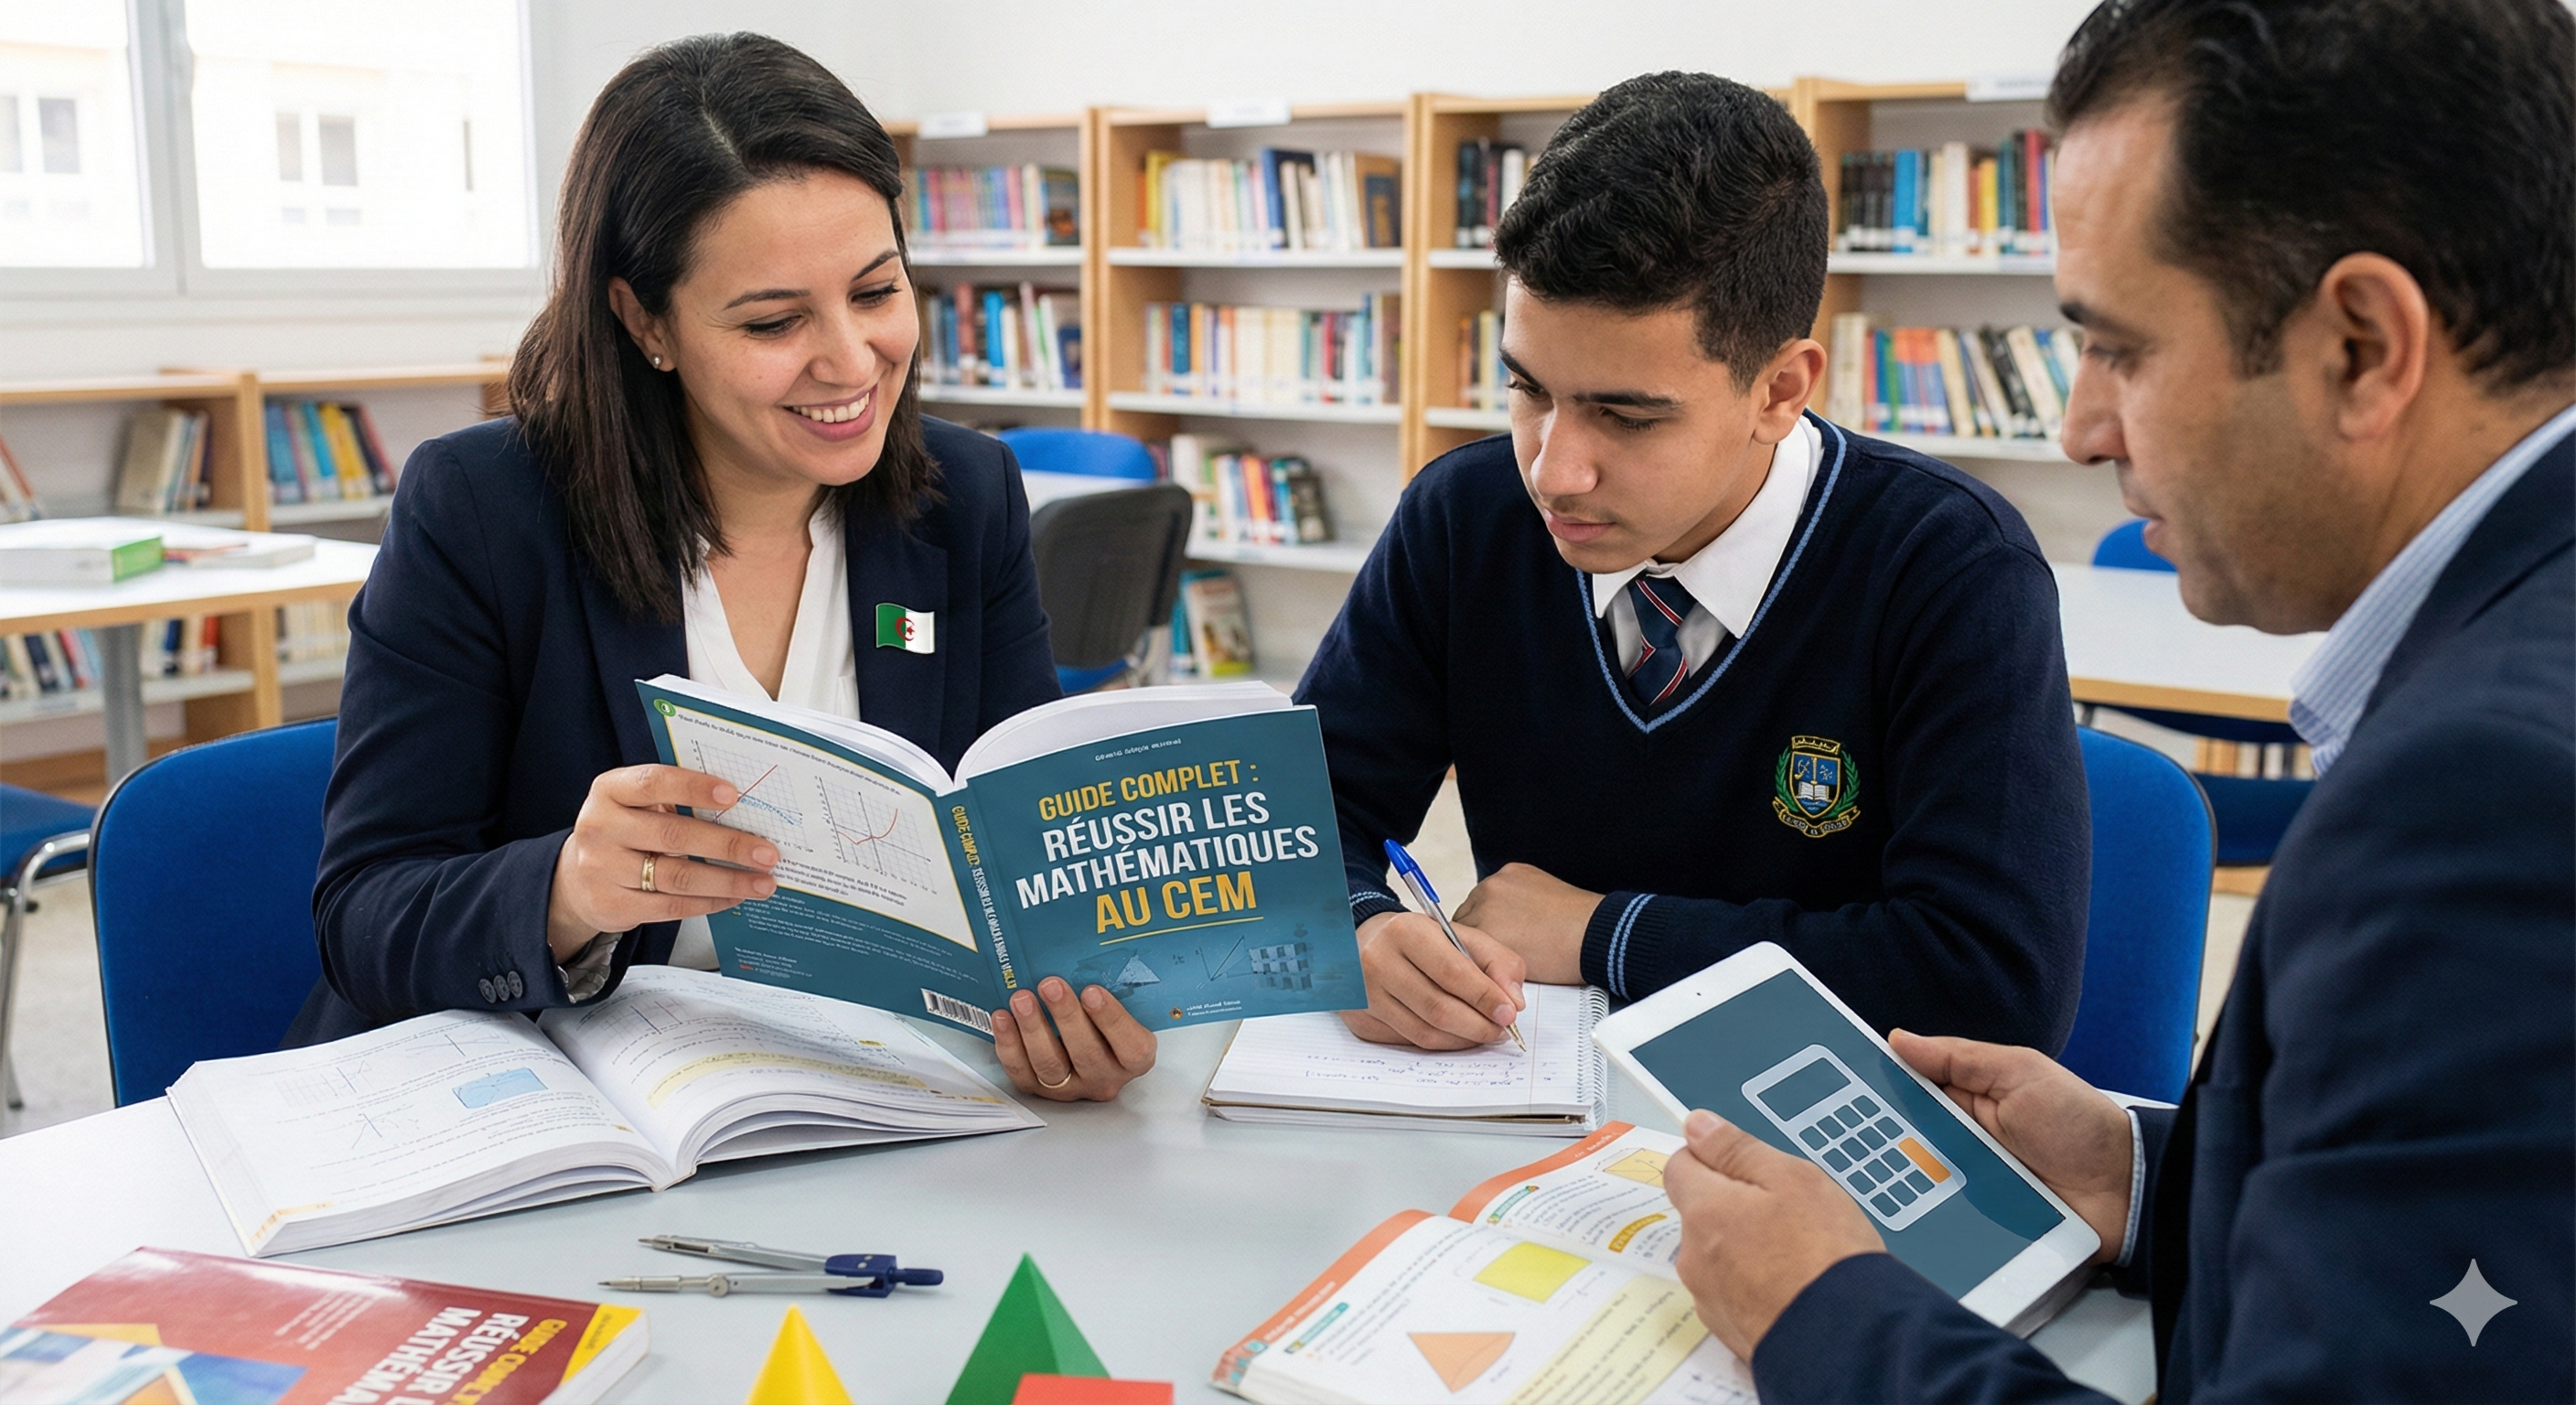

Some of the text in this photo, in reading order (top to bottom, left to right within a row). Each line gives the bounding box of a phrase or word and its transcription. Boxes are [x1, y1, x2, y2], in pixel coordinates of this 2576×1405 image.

[1038, 785, 1116, 820] GUIDE
[1121, 760, 1241, 803] COMPLET
[1042, 791, 1270, 862] RÉUSSIR LES
[1015, 826, 1319, 909] MATHÉMATIQUES
[1097, 870, 1257, 934] AU CEM
[325, 1306, 482, 1405] MATHÉMA
[405, 1313, 530, 1394] RÉUSSIR
